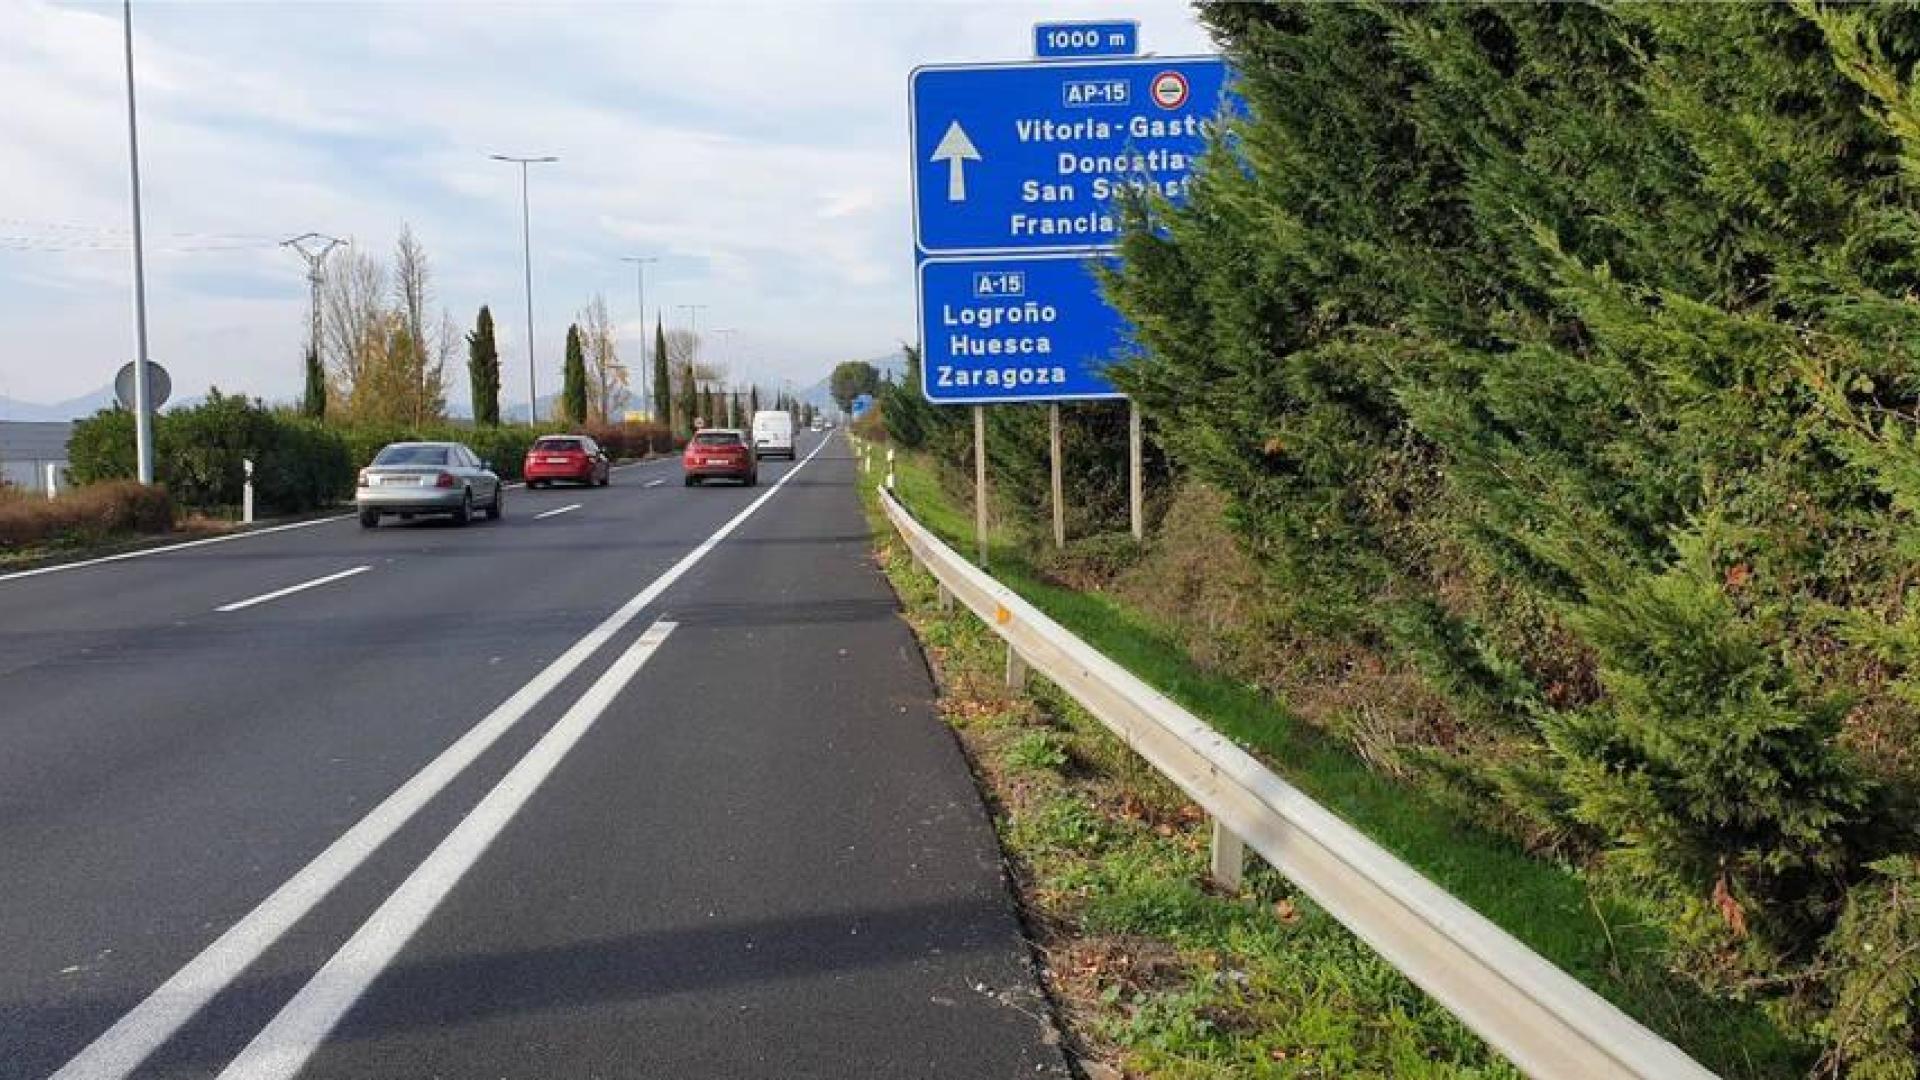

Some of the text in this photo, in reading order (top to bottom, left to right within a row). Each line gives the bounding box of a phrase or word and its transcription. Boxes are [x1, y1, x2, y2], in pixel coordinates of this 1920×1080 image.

[1046, 31, 1126, 48] 1000 m
[1067, 83, 1125, 102] AP-15
[1022, 179, 1075, 202] San
[978, 275, 1023, 293] A-15
[943, 302, 1057, 328] Logroño
[951, 334, 1051, 356] Huesca
[937, 365, 1066, 389] Zaragoza
